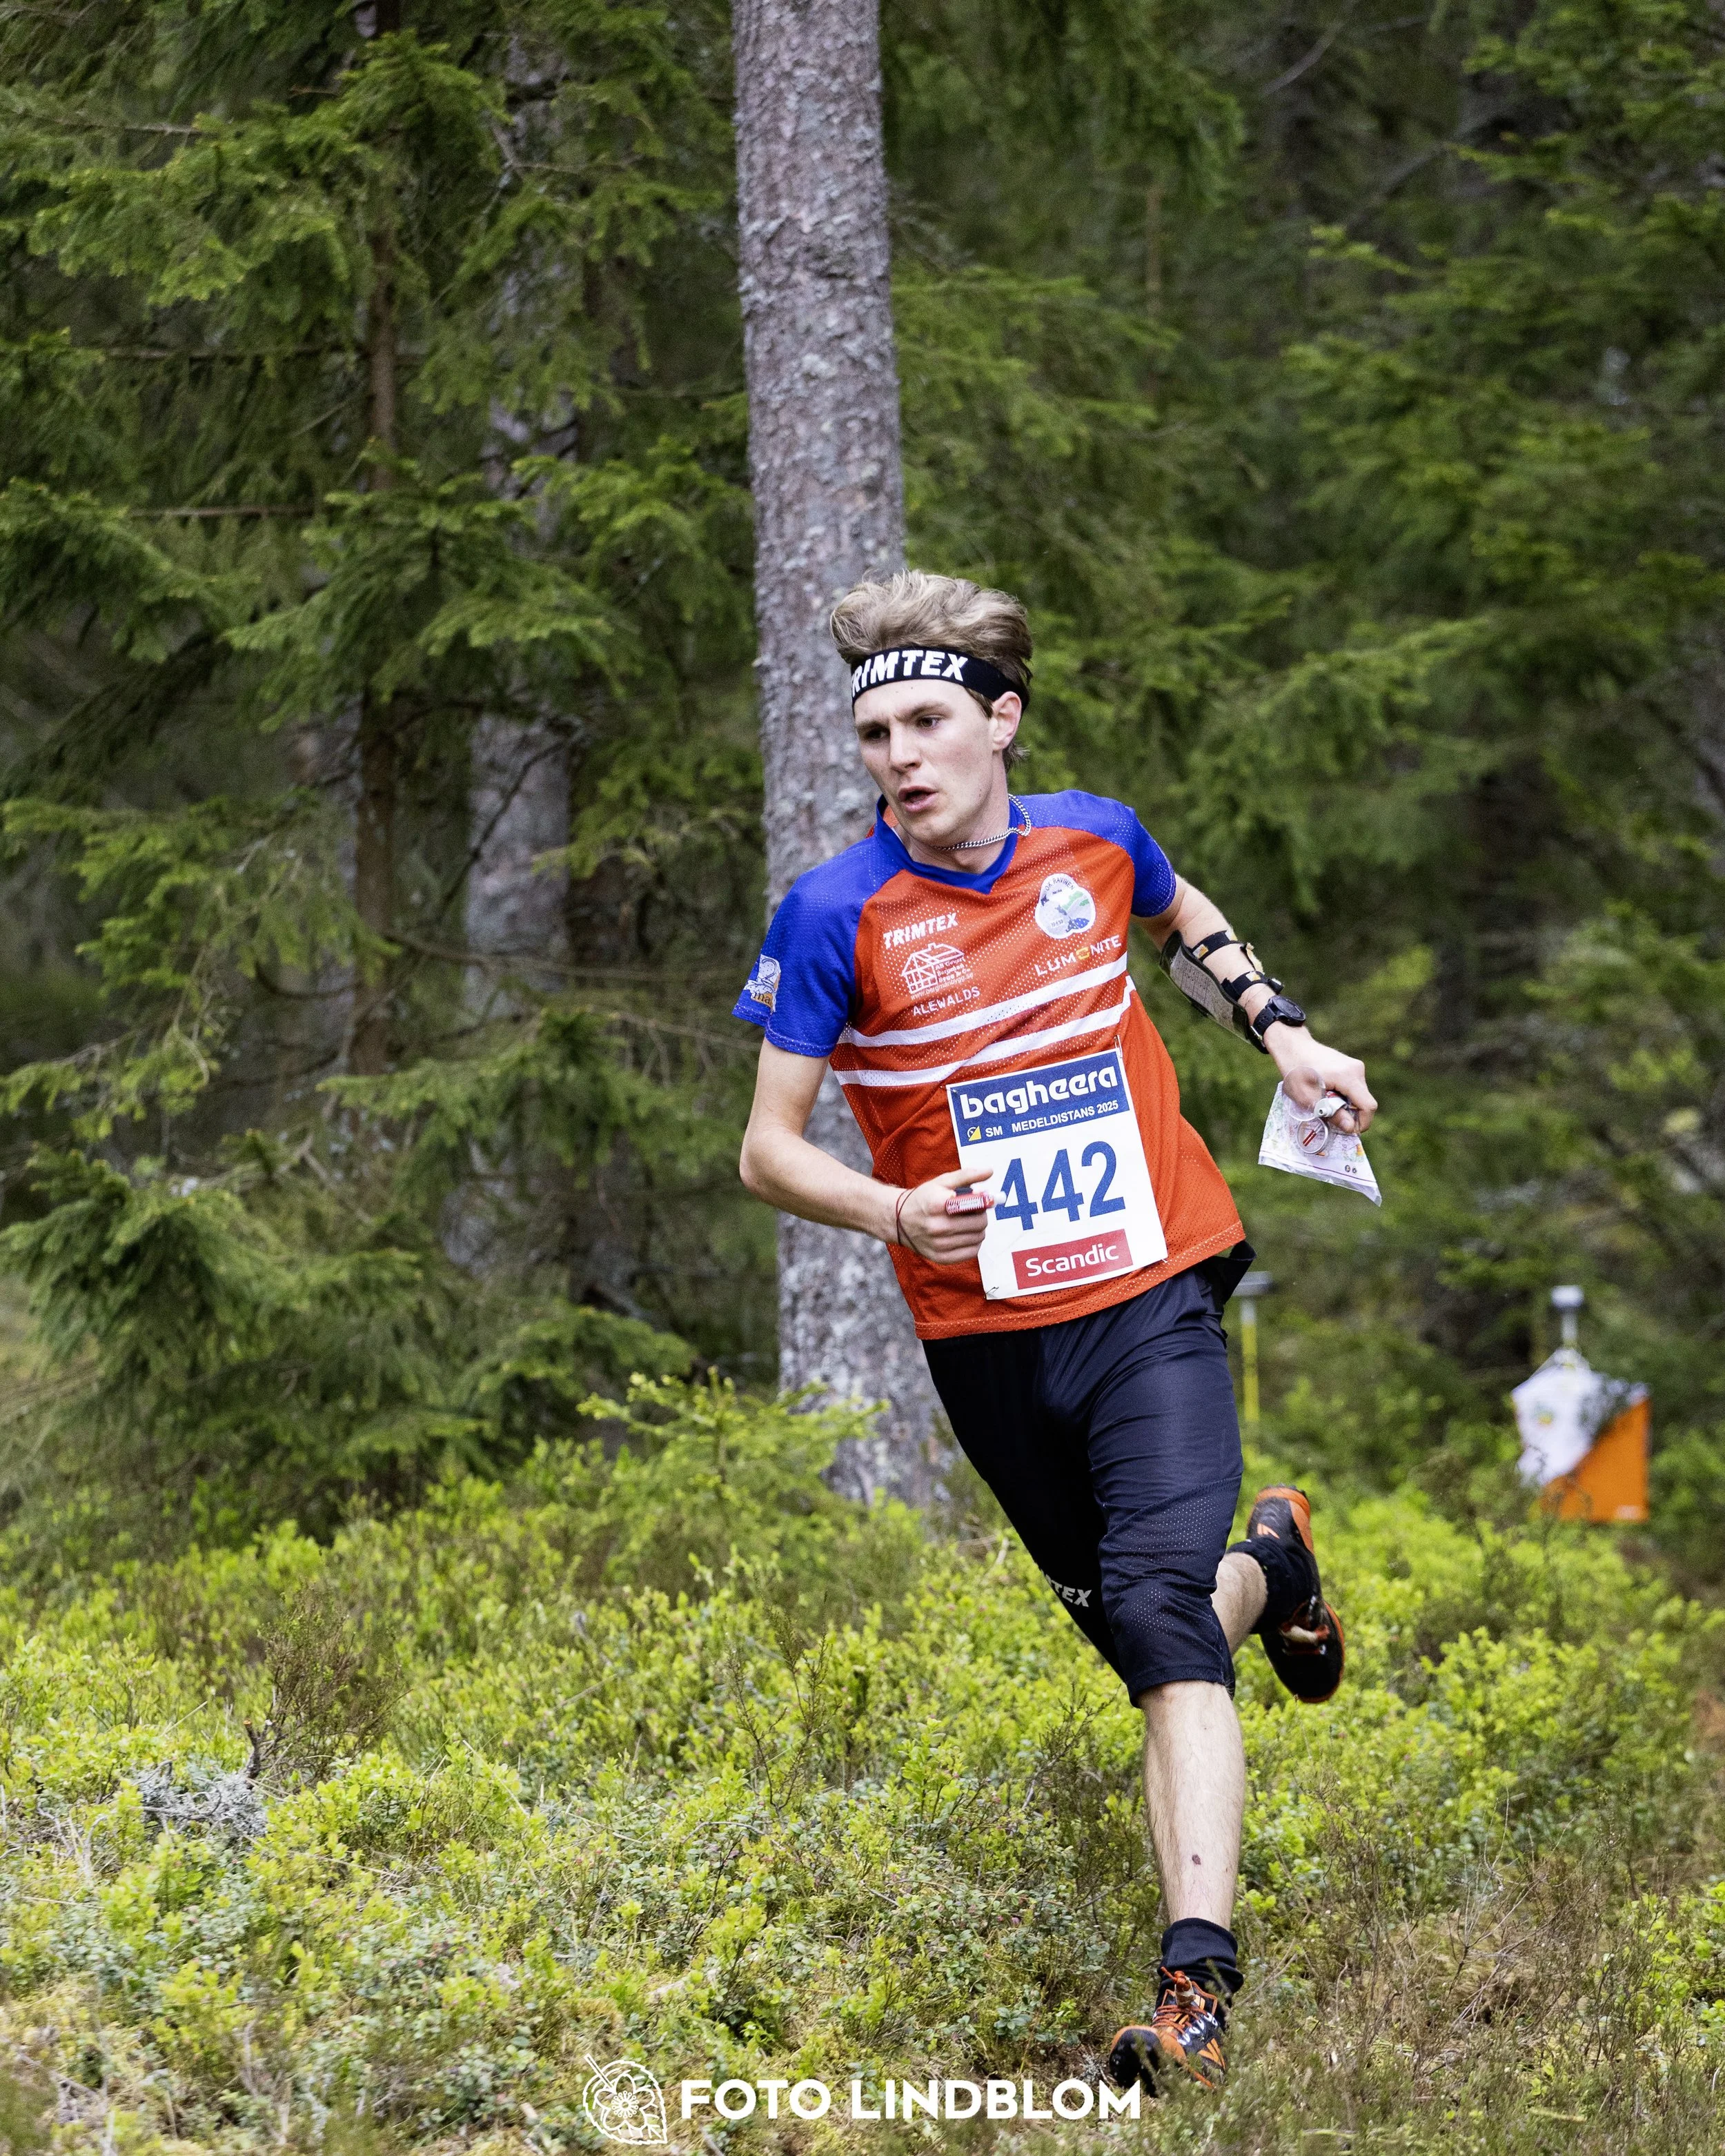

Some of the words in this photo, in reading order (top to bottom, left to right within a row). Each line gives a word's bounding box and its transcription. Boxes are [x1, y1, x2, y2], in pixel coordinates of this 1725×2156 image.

[851, 650, 968, 698] RIMTEX
[883, 912, 958, 950] TRIMTEX
[913, 986, 980, 1016] ALEWALDS
[960, 1066, 1118, 1120] bagheera
[985, 1125, 1003, 1138] SM
[1011, 1107, 1095, 1133] MEDELDISTANS
[1096, 1100, 1119, 1114] 2025
[994, 1140, 1126, 1231] 442
[1025, 1243, 1120, 1276] Scandic
[1045, 1574, 1092, 1608] TEX
